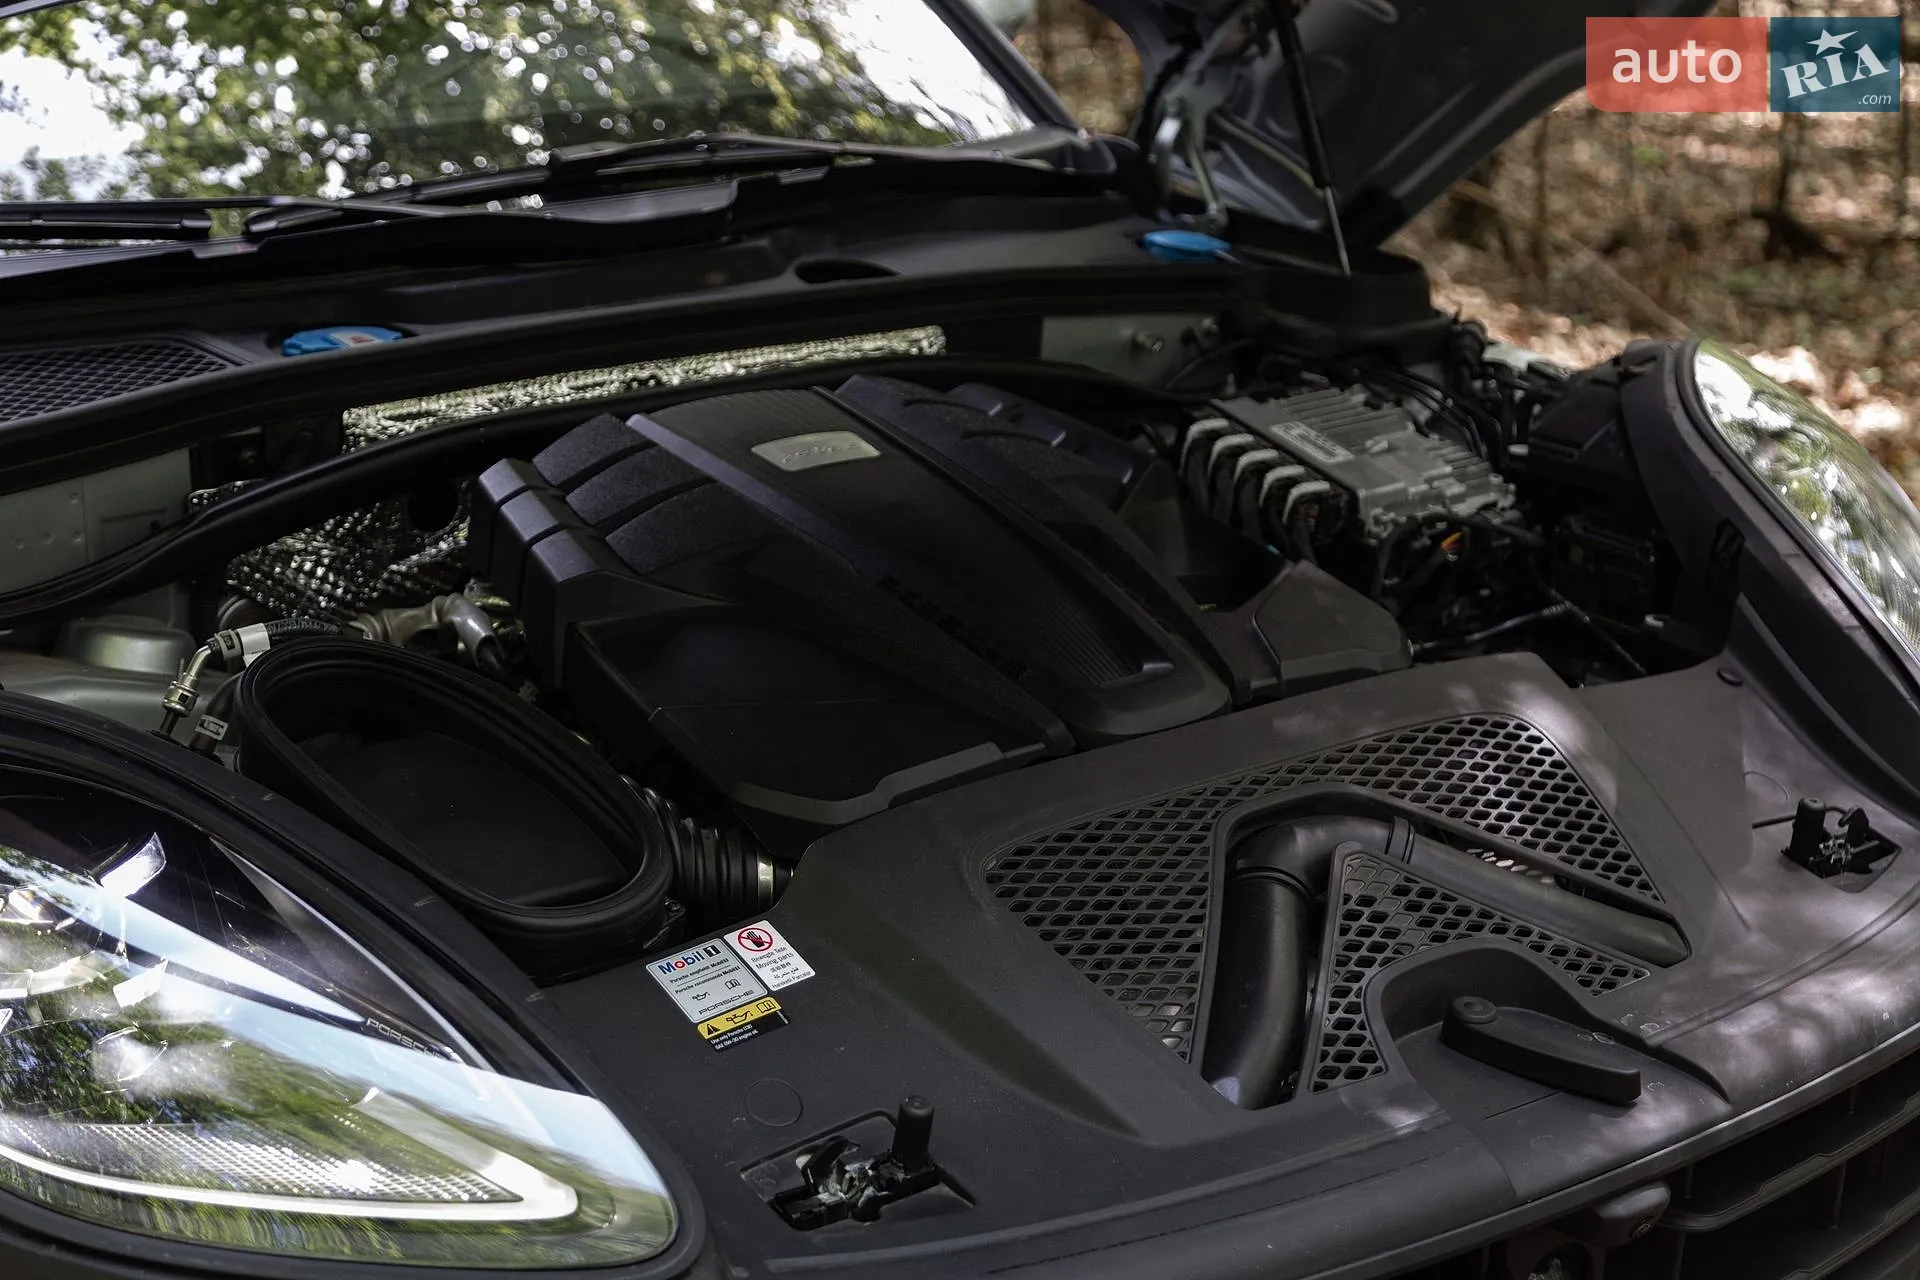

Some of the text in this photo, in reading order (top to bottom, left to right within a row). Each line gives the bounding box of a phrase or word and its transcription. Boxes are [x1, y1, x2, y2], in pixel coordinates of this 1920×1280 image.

[658, 951, 705, 975] Mobil
[756, 959, 778, 969] Moving
[778, 952, 794, 962] parts
[675, 984, 694, 994] Porsche
[698, 990, 755, 1014] PORSCHE
